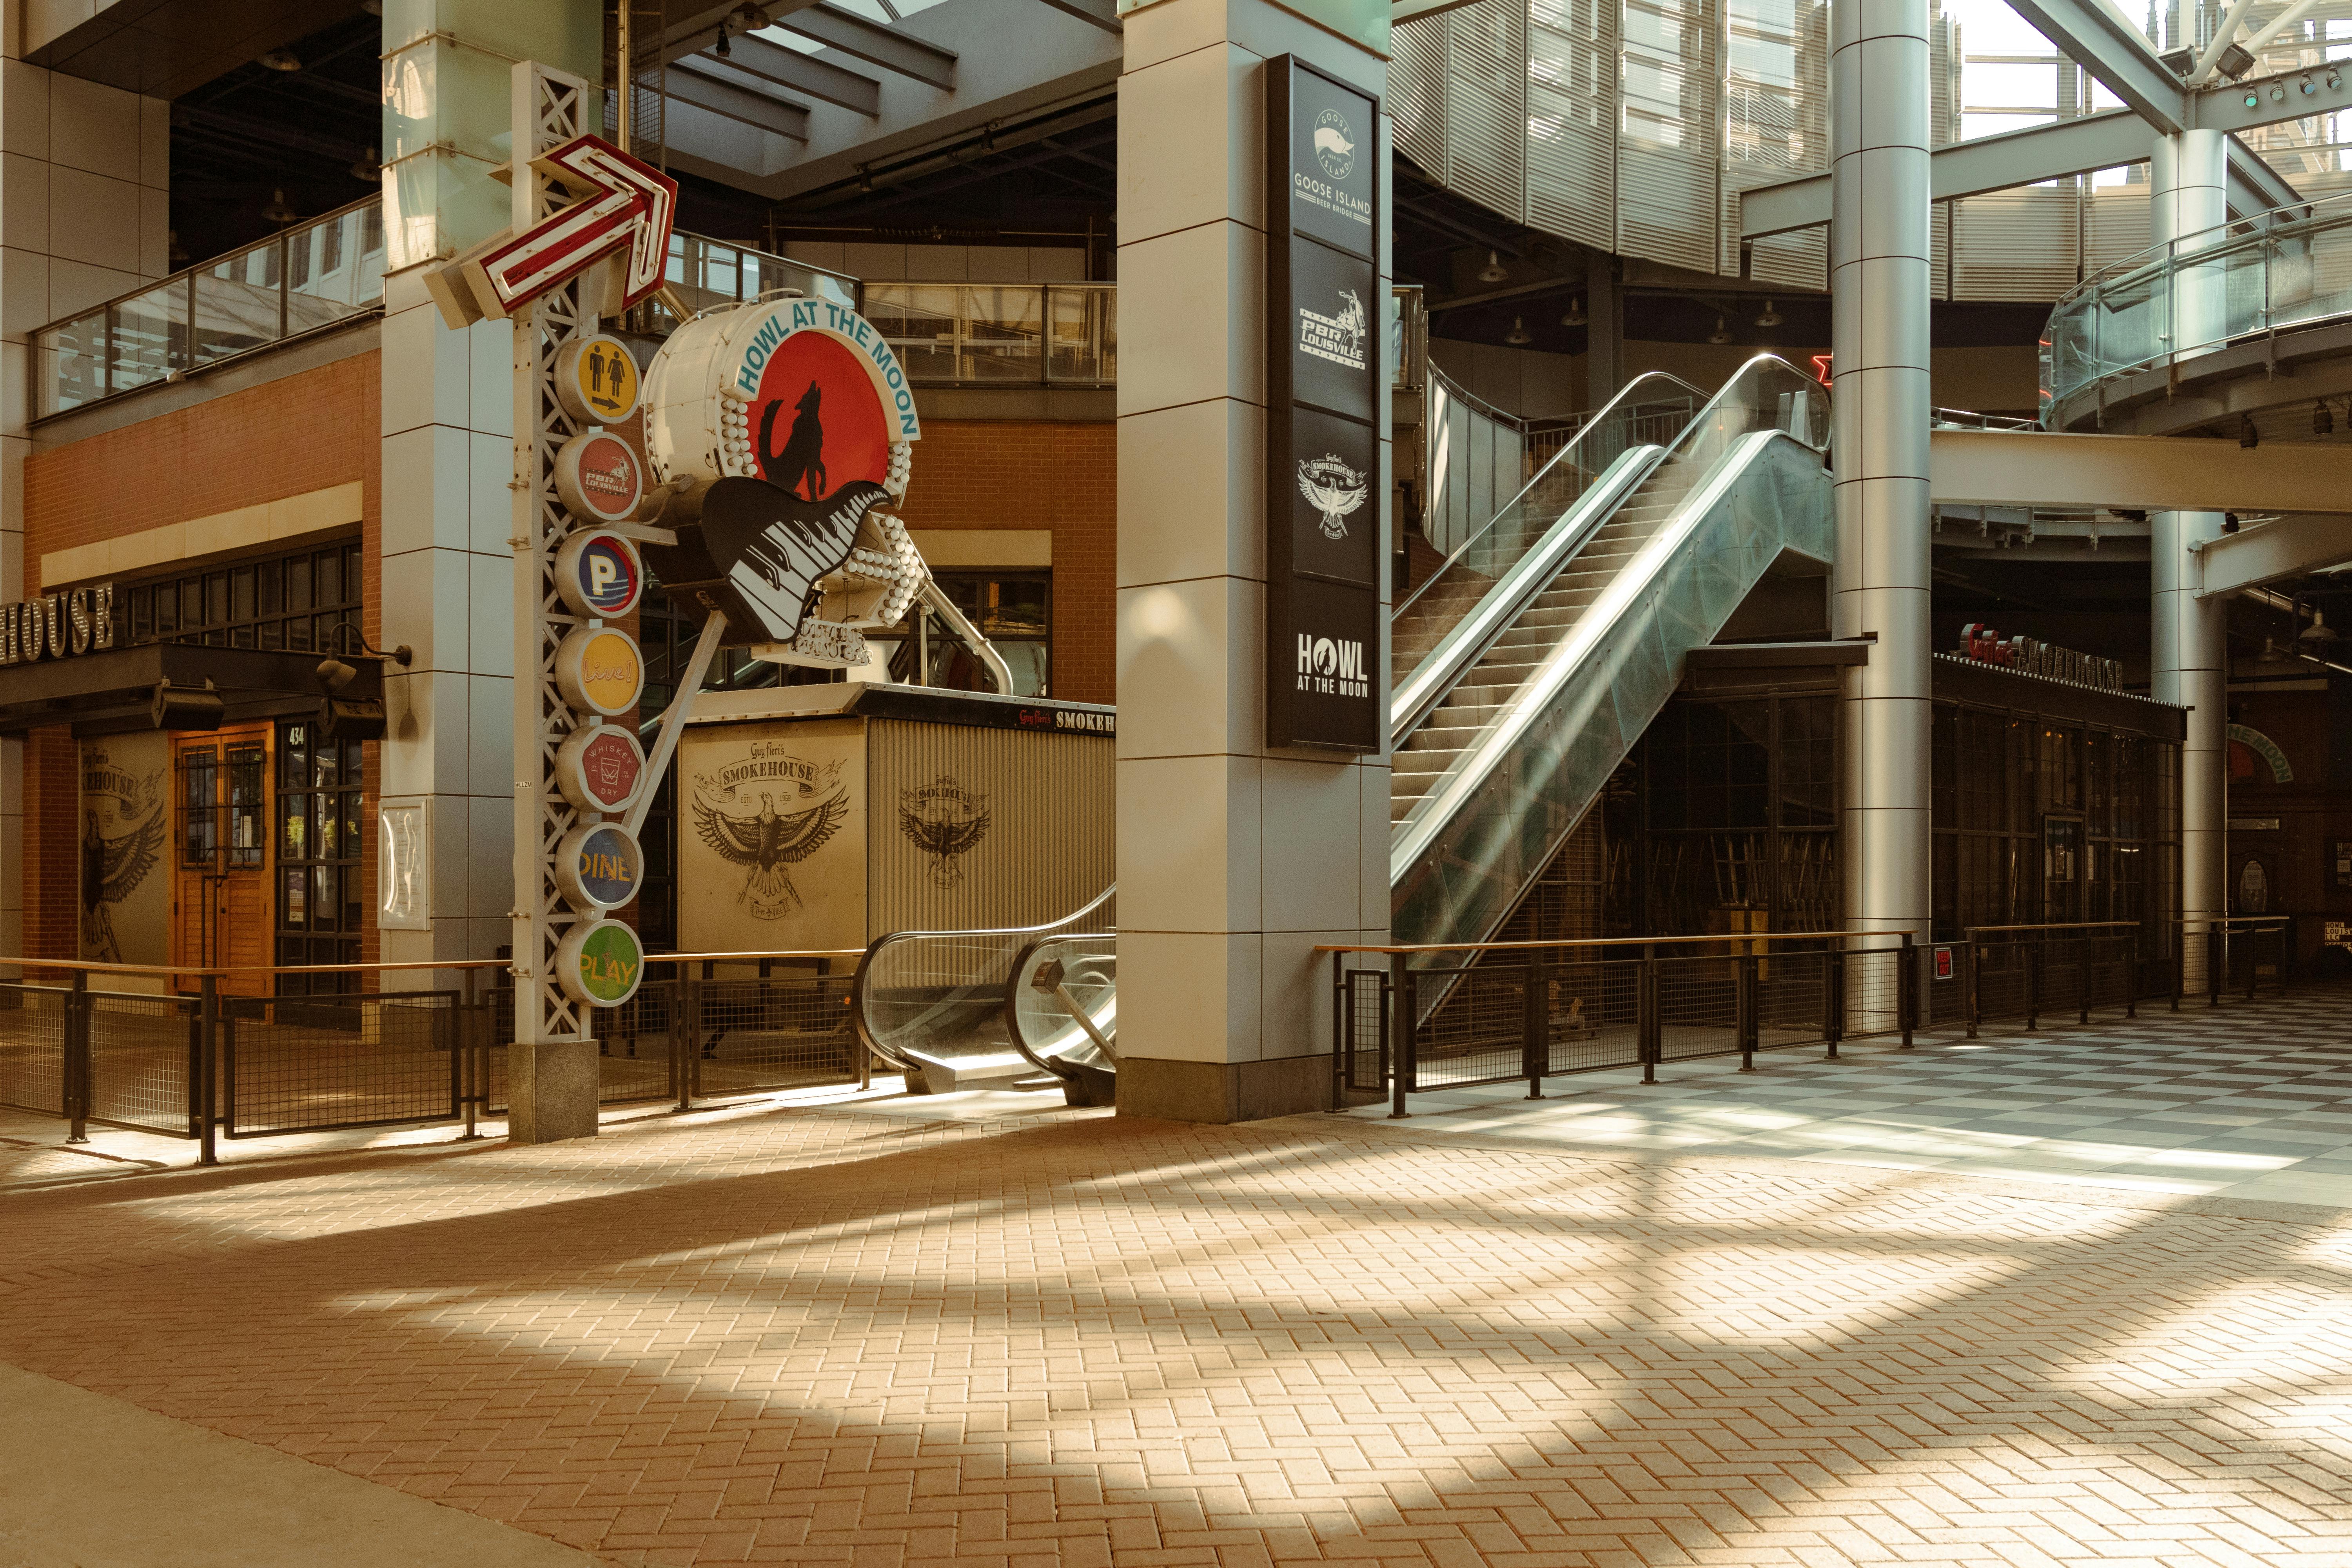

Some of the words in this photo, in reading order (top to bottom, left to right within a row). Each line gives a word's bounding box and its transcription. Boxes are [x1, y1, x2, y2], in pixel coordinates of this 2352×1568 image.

[1321, 113, 1348, 134] GOOSE
[1321, 155, 1349, 176] ISLAND
[1295, 173, 1331, 198] GOOSE
[1336, 190, 1370, 214] ISLAND
[1317, 198, 1330, 209] BEER
[1333, 204, 1352, 218] BRIDGE
[1302, 319, 1341, 341] PBR
[1301, 330, 1363, 360] LOUISVILLE
[739, 315, 790, 394] HOWL
[793, 301, 818, 329] AT
[826, 303, 871, 348] THE
[871, 341, 917, 434] MOON
[586, 473, 614, 483] PBR
[1313, 462, 1354, 479] SMOKEHOUSE
[586, 478, 629, 493] LOUISVILLE
[590, 555, 616, 595] P
[0, 582, 113, 665] HOUSE
[1298, 633, 1368, 681] HOWL
[584, 659, 632, 682] Live!
[1298, 675, 1310, 691] AT
[1315, 677, 1334, 694] THE
[1340, 680, 1368, 698] MOON
[1056, 711, 1116, 731] SMOKEH
[290, 727, 304, 745] 434
[589, 746, 632, 764] WHISKEY
[751, 743, 764, 759] Guy
[2227, 725, 2252, 742] HE
[2254, 736, 2290, 781] MOON
[723, 761, 814, 785] SMOKEHOUSE
[579, 852, 631, 882] DINE
[580, 953, 636, 985] PLAY
